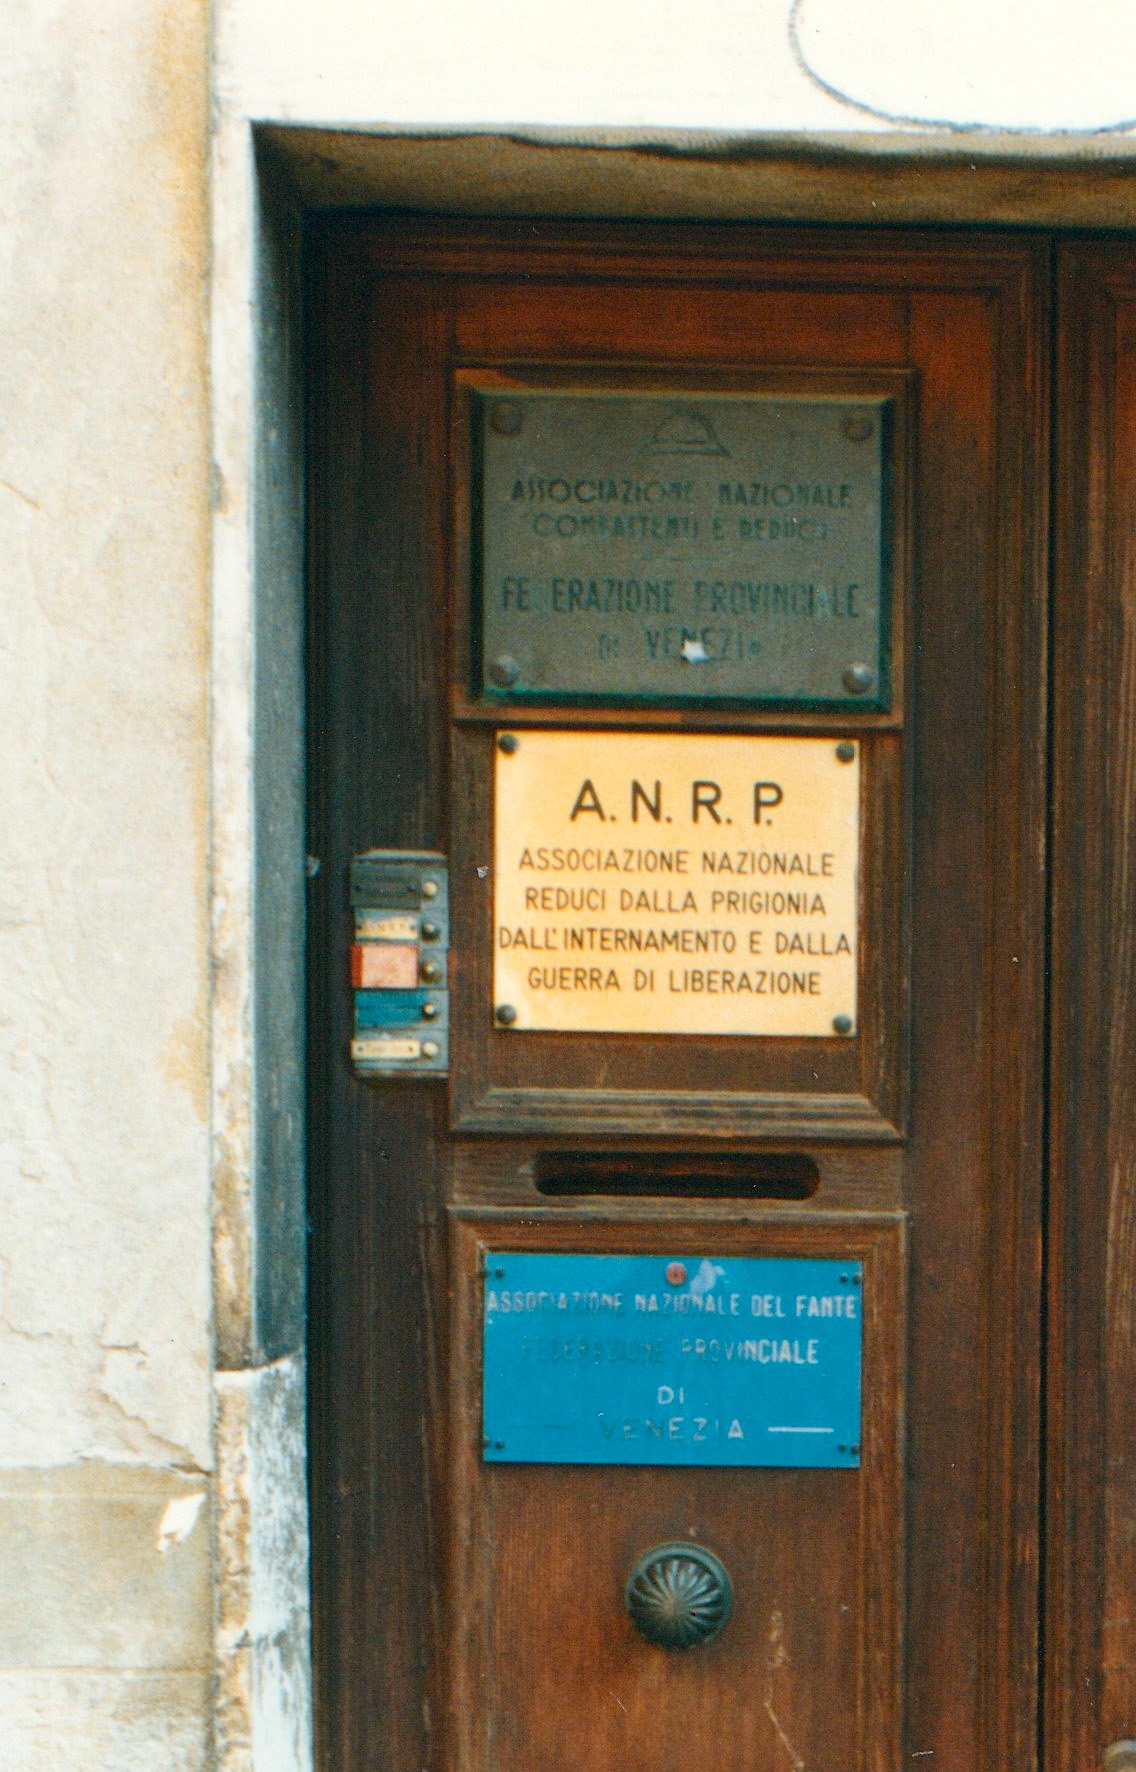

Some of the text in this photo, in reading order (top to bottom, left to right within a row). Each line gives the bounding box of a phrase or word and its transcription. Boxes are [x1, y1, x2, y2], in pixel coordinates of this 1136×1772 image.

[511, 477, 851, 508] ASSOCIAZIONE NAZIONALE
[534, 512, 828, 541] COMBATTENTI E REDUCI
[519, 848, 835, 876] ASSOCIAZIONE NAZIONALE
[525, 887, 826, 915] REDUCI DALLA PRIGIONIA
[500, 927, 851, 956] DALL'INTERNAMENTO E DALLA
[528, 967, 821, 995] GUERRA DI LIBERAZIONE
[487, 1290, 856, 1319] ASSOCIAZIONE NAZIONALE DEL FANTE
[681, 1338, 820, 1364] PROVINCIALE
[657, 1386, 684, 1405] DI
[600, 1418, 744, 1442] VENEZIA
